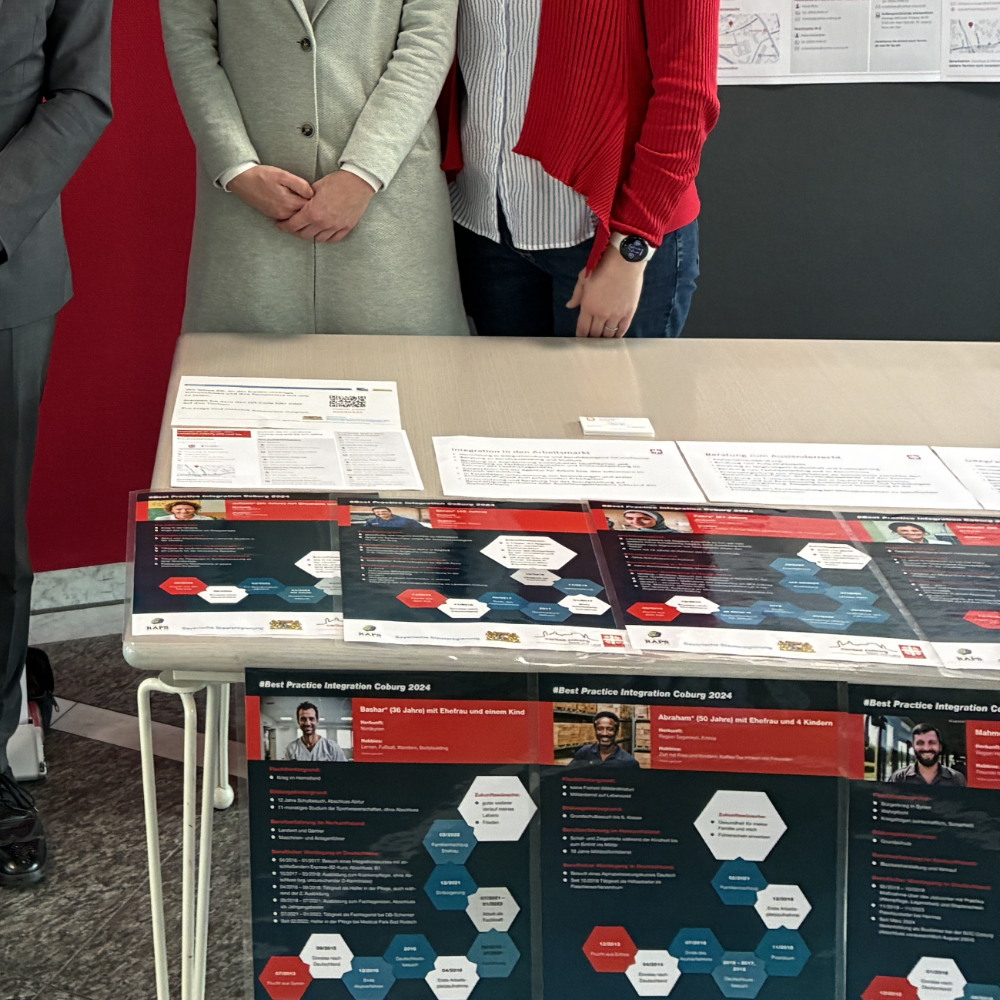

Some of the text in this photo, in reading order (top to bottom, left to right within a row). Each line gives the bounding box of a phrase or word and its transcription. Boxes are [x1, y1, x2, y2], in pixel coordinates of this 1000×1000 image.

[259, 680, 431, 692] #Best Practice Integration Coburg 2024
[553, 686, 732, 700] #Best Practice Integration Coburg 2024
[402, 707, 425, 716] Jahre)
[426, 707, 438, 715] mit
[440, 708, 467, 716] Ehefrau
[469, 708, 483, 716] und
[863, 698, 988, 713] #Best Practice Integration
[710, 715, 734, 724] Jahre)
[735, 716, 748, 724] mit
[749, 717, 778, 725] Ehefrau
[780, 718, 795, 726] und
[803, 719, 833, 727] Kindern
[975, 729, 1000, 738] Mahm
